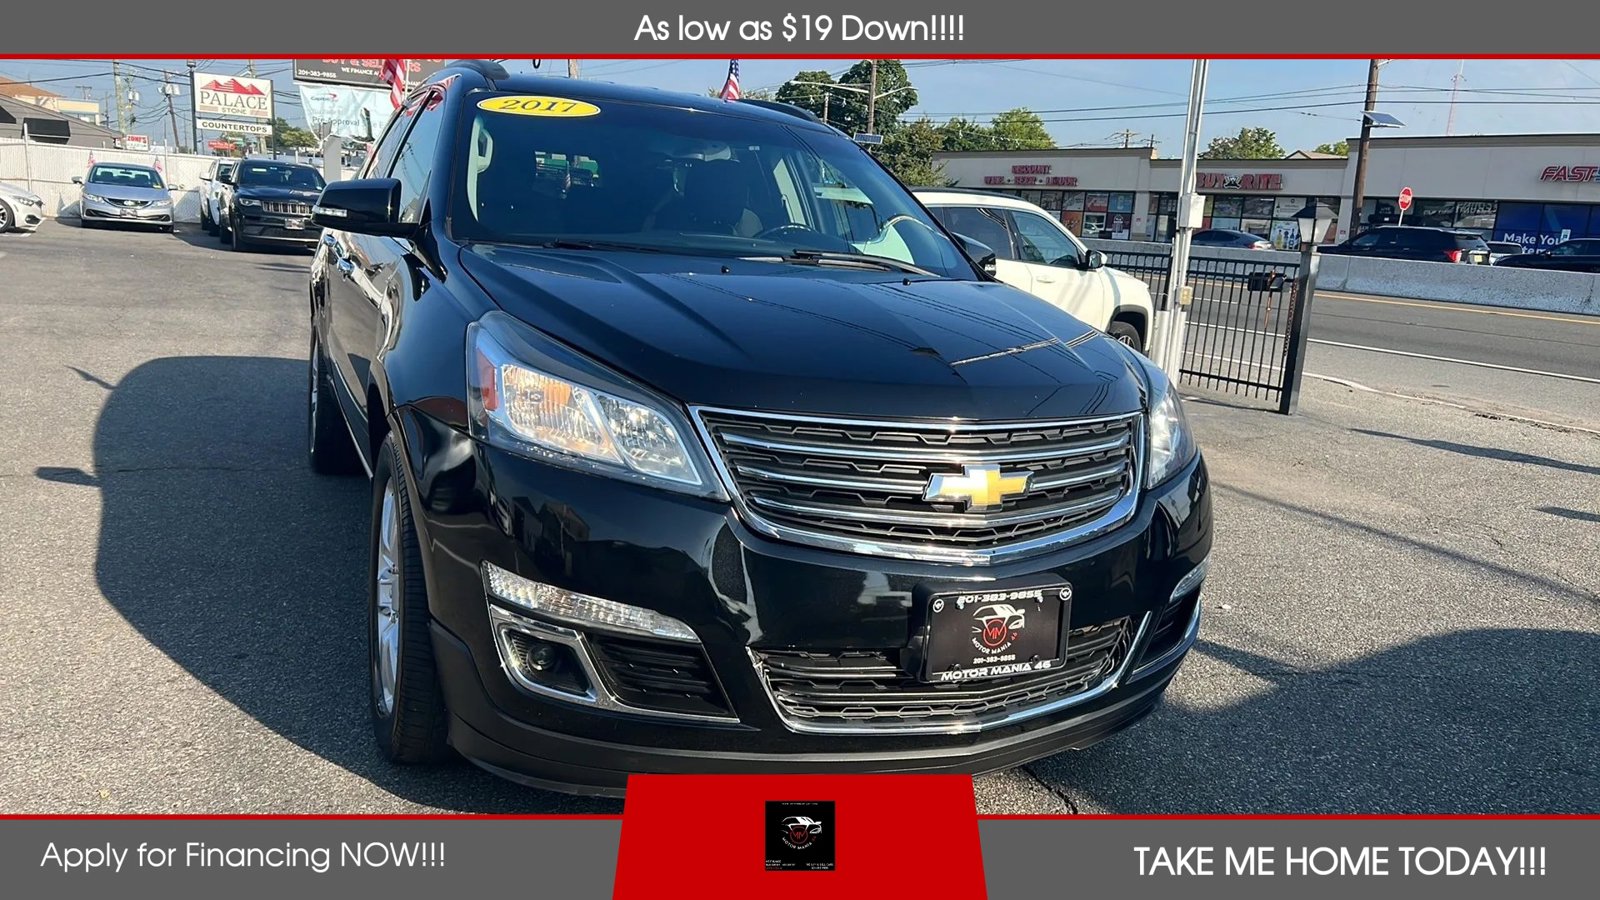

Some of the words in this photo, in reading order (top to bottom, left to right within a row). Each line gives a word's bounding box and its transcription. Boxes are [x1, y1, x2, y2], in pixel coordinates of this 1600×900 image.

[298, 69, 337, 79] 201-383-9855
[200, 90, 268, 110] PALACE
[499, 99, 578, 112] 2017
[221, 107, 247, 115] STONE
[201, 121, 268, 133] COUNTERTOPS
[312, 116, 360, 128] Pre-Approval
[1540, 165, 1599, 182] FAST
[1195, 172, 1226, 189] BUY
[1241, 174, 1283, 190] RITE
[1503, 232, 1537, 245] Make
[957, 590, 1042, 603] 201-383-9855
[971, 637, 991, 655] MOTOR
[991, 642, 1012, 655] MANIA
[940, 668, 989, 682] MOTOR
[990, 662, 1032, 676] MANIA
[1034, 660, 1052, 670] 46
